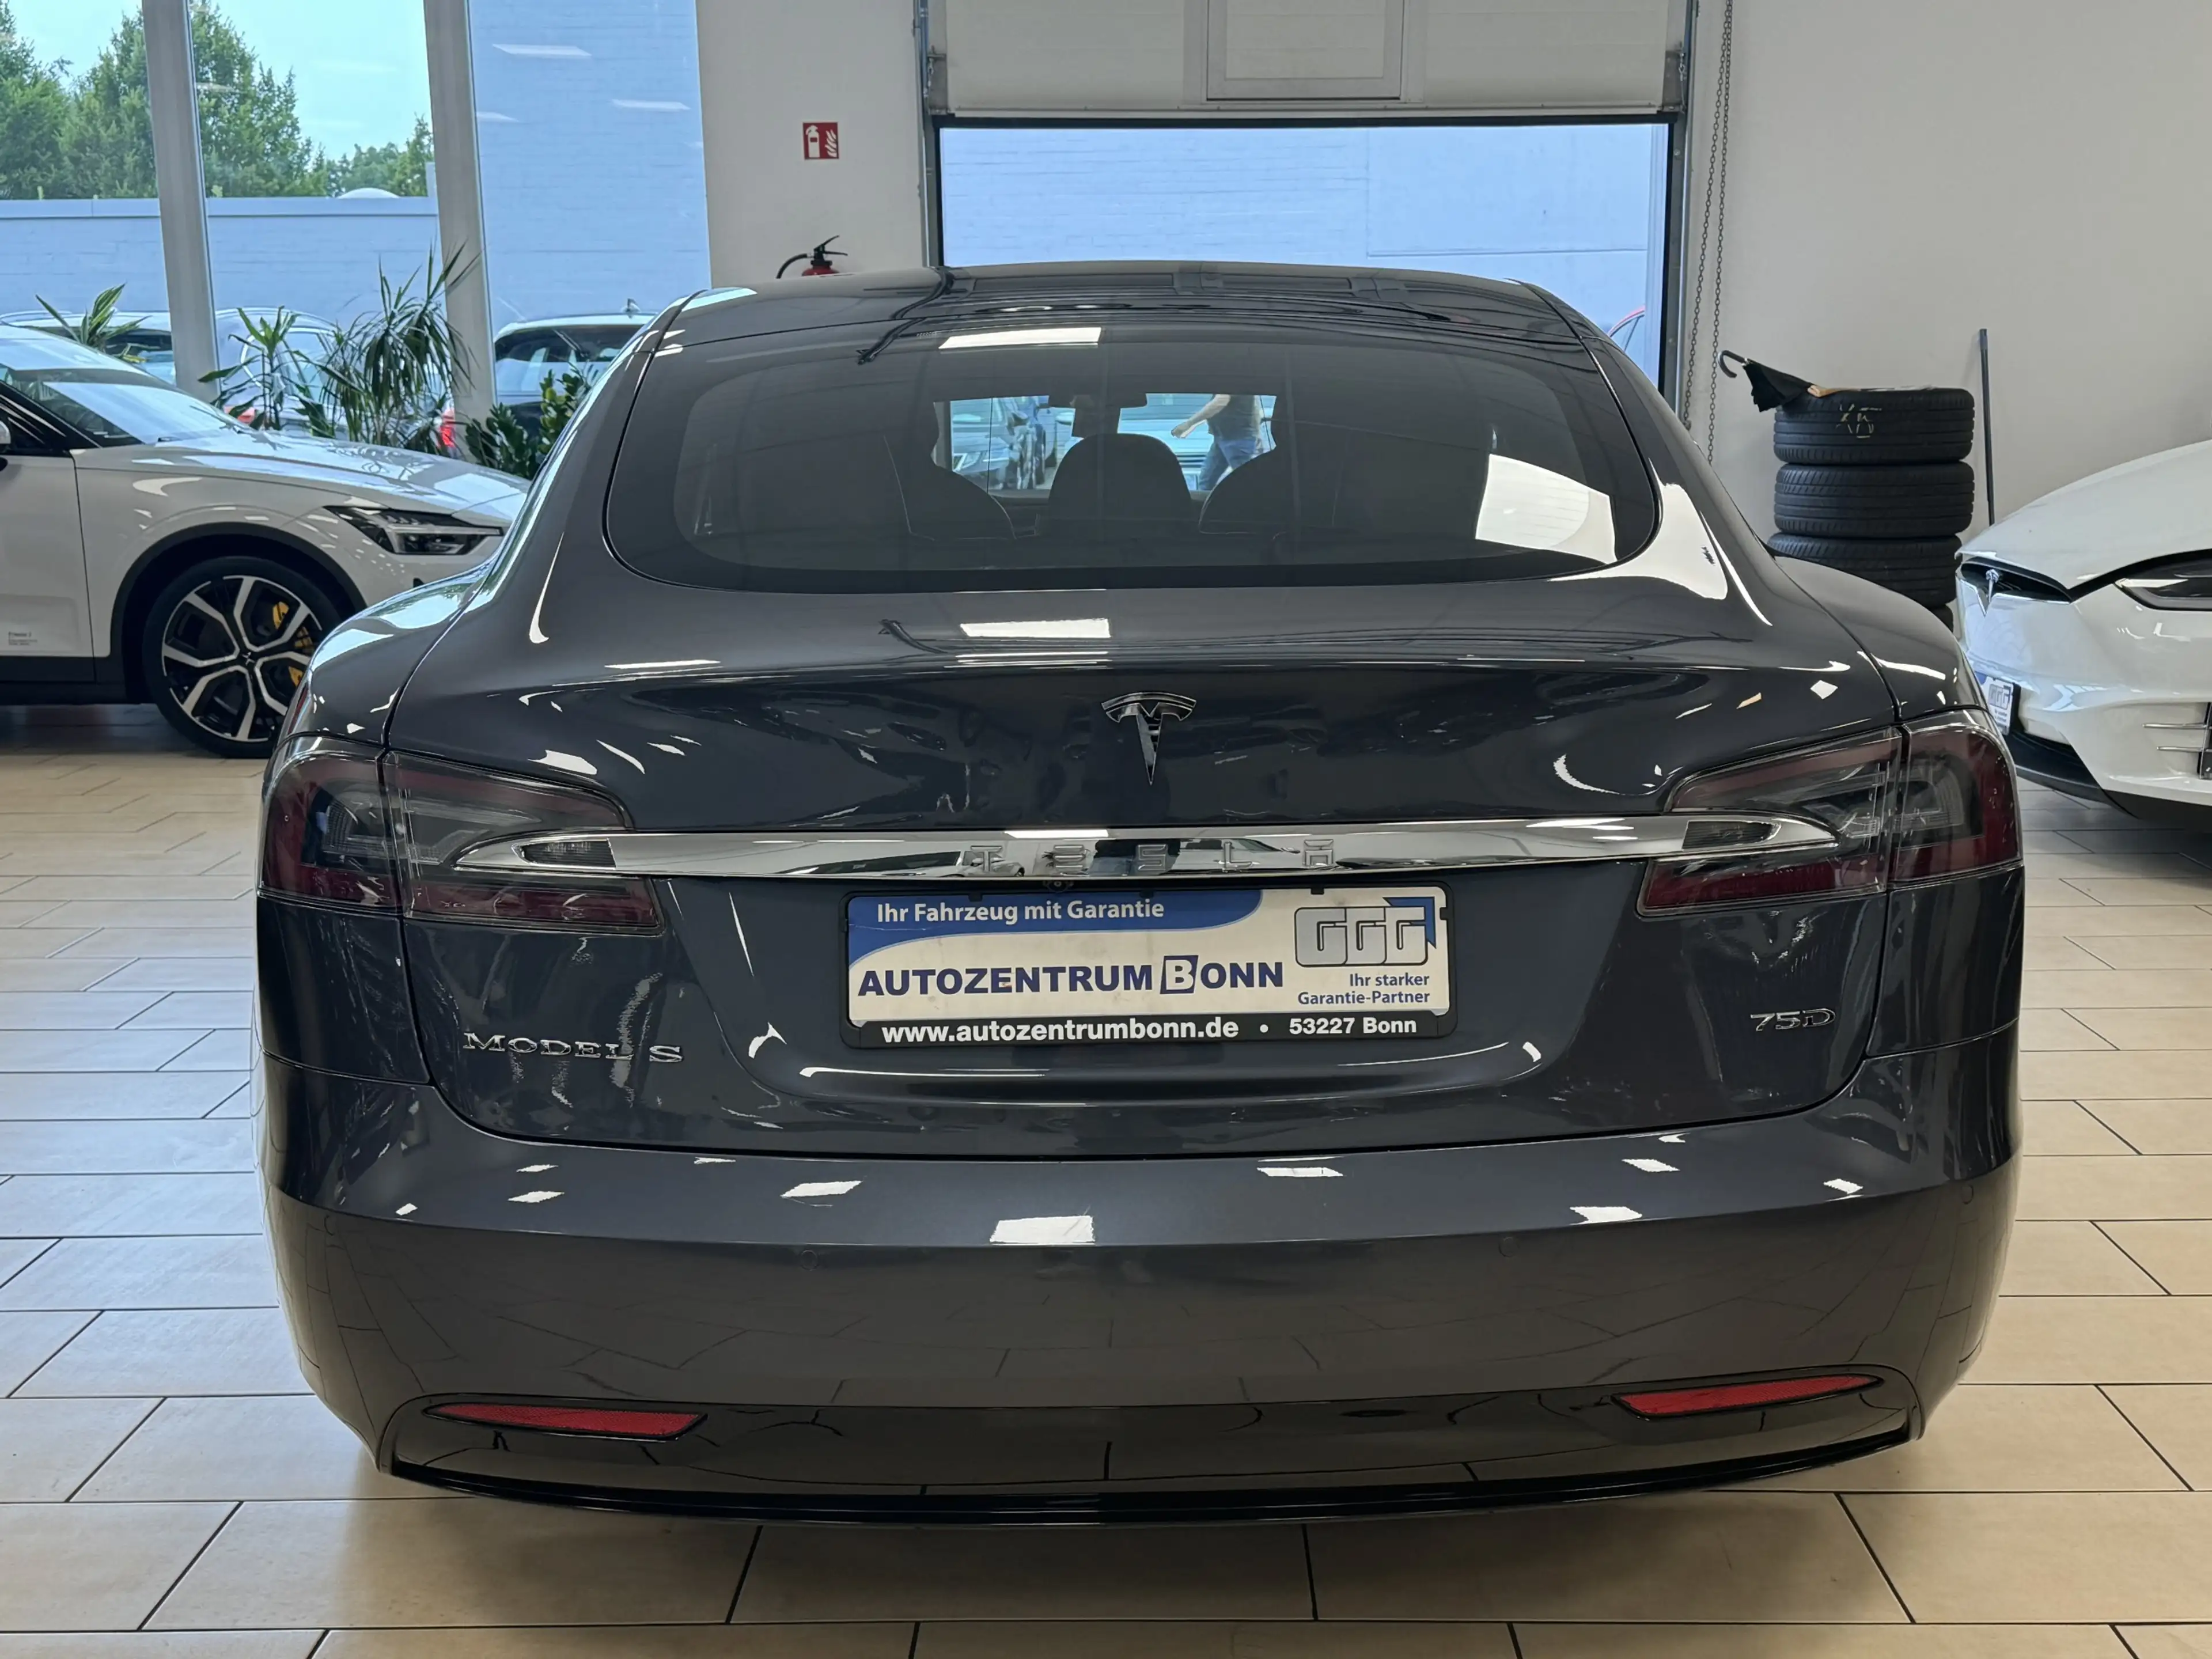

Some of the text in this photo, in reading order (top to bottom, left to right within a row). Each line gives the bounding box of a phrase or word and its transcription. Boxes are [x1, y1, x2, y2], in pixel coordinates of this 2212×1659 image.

[971, 839, 1334, 873] TESLA
[877, 899, 1164, 925] Ihr Fahrzeug mit Garantie
[858, 955, 1283, 996] AUTOZENTRUM BONN
[1350, 972, 1430, 987] Ihr starker
[1298, 990, 1430, 1005] Garantie-Partner
[881, 1016, 1417, 1043] www.autozentrumbonn.de 53227 Bonn
[1750, 1008, 1836, 1031] 75D
[463, 1032, 684, 1063] MODEL S
